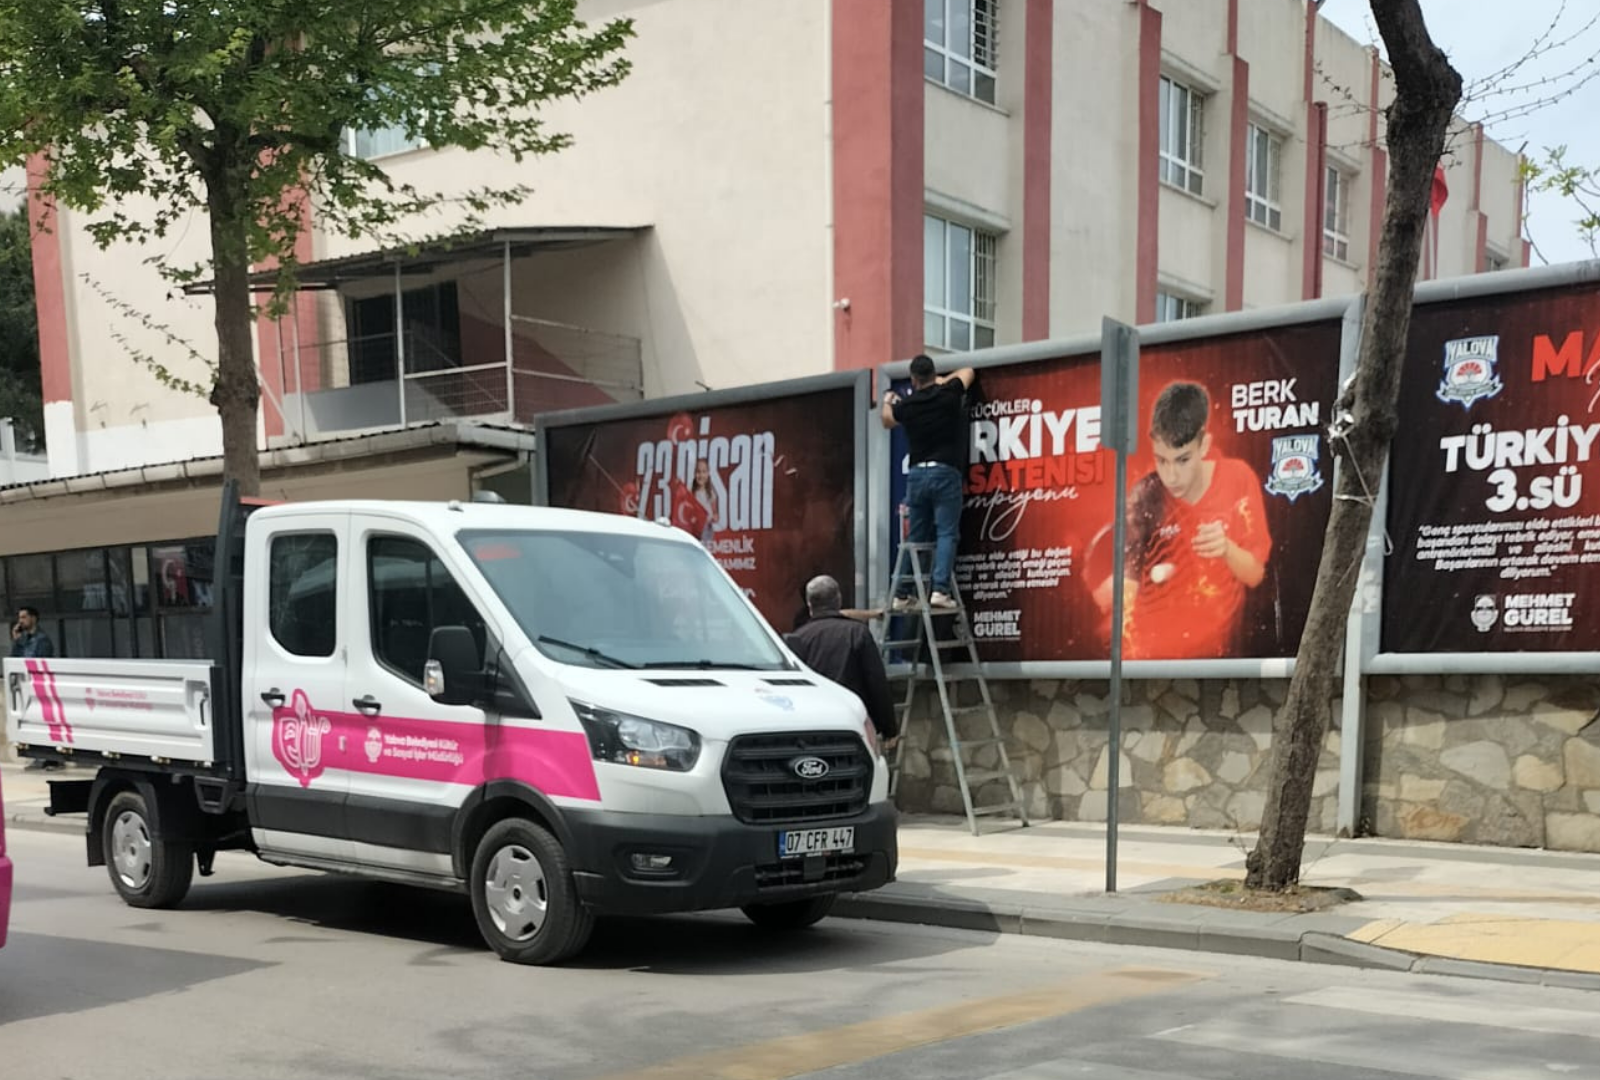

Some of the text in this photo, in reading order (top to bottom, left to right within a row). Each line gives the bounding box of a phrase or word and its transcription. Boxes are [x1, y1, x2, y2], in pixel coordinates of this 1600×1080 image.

[1447, 338, 1497, 361] YALOVA
[1231, 377, 1297, 409] BERK
[970, 399, 1031, 419] ÜÇÜKLER
[1232, 401, 1320, 433] TURAN
[1274, 438, 1318, 459] YALOVA
[1485, 465, 1583, 512] 3.SÜ
[963, 485, 1083, 541] mpiyonu
[1504, 593, 1576, 609] MEHMET
[974, 609, 1022, 623] MEHMET
[801, 761, 823, 776] Ford
[786, 828, 853, 852] 07 CFR 447
